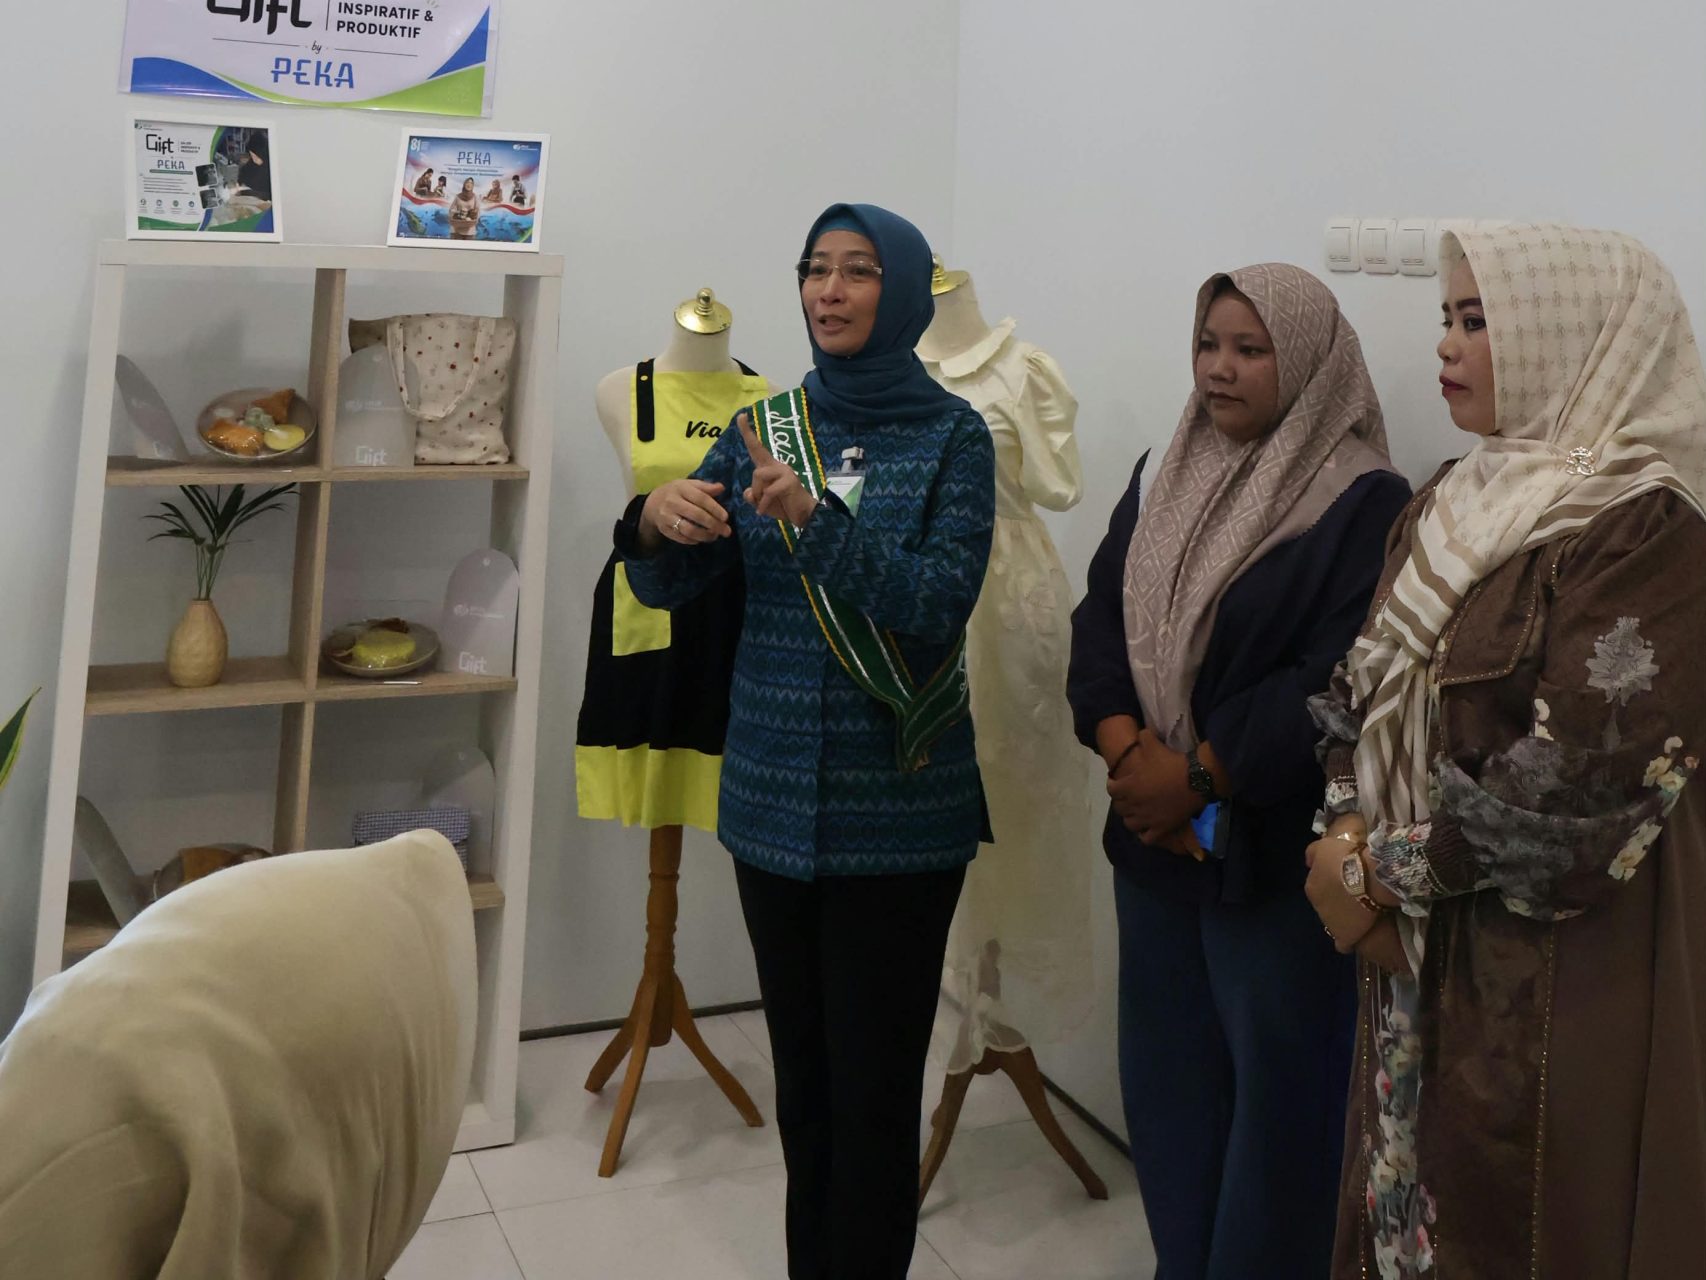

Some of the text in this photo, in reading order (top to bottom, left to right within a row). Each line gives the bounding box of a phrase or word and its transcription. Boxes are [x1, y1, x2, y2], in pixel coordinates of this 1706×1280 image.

[337, 1, 434, 22] INSPIRATIF &
[336, 20, 422, 39] PRODUKTIF
[311, 40, 322, 55] by
[270, 57, 355, 89] PEKA
[145, 133, 175, 155] Gift
[157, 159, 185, 170] PEKA
[456, 150, 492, 166] PEKA
